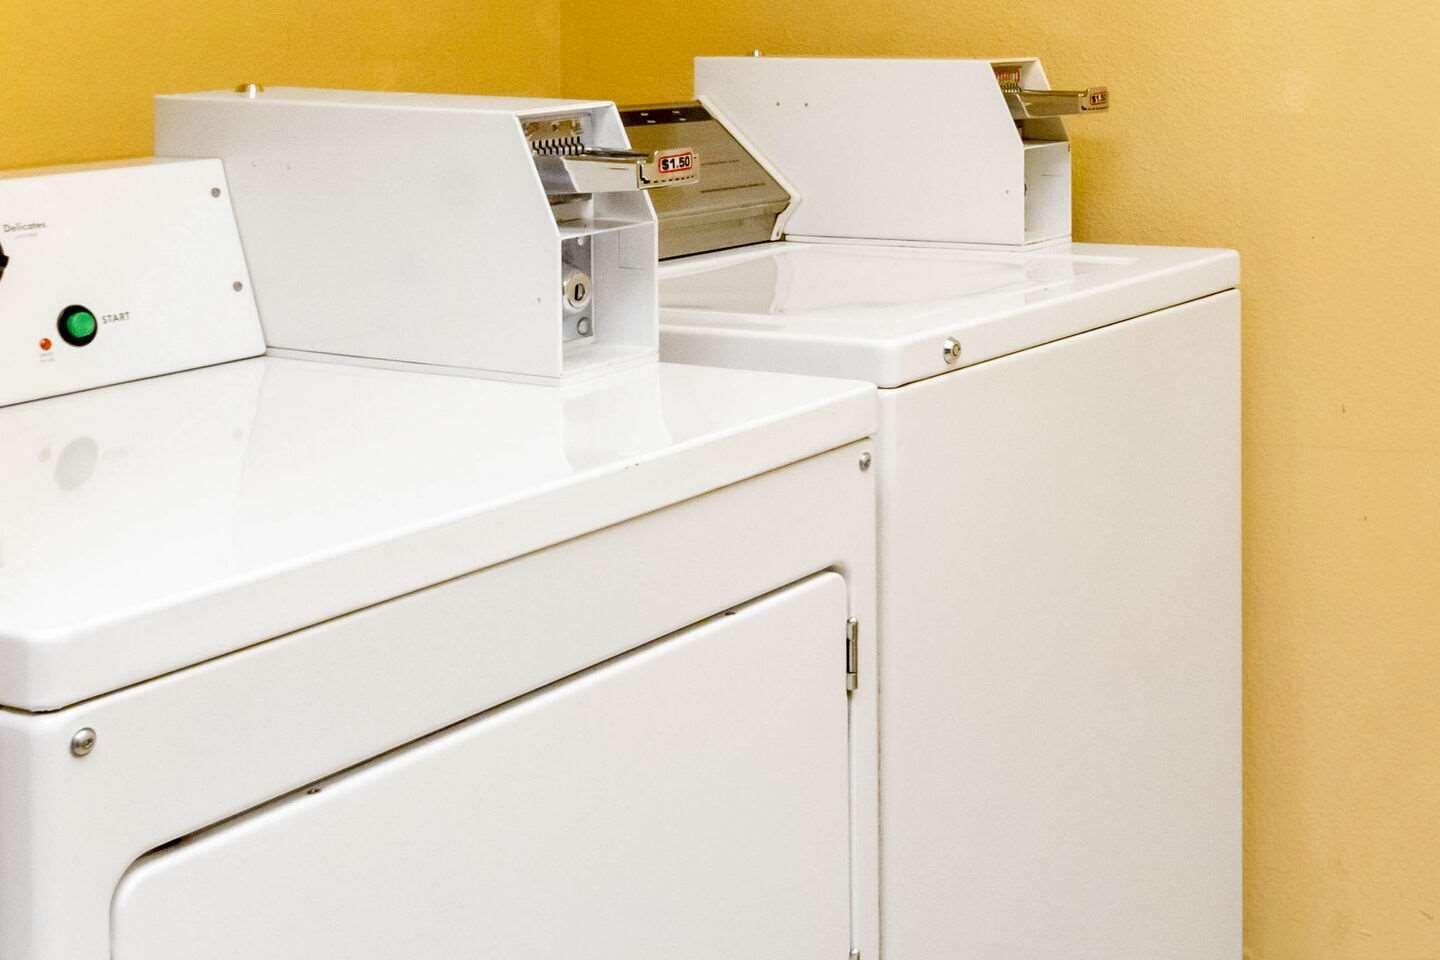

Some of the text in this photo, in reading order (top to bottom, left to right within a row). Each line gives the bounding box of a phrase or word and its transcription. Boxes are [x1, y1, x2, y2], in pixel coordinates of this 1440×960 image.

[662, 156, 690, 170] $1.50
[3, 222, 47, 233] Delicates
[102, 312, 130, 324] START
